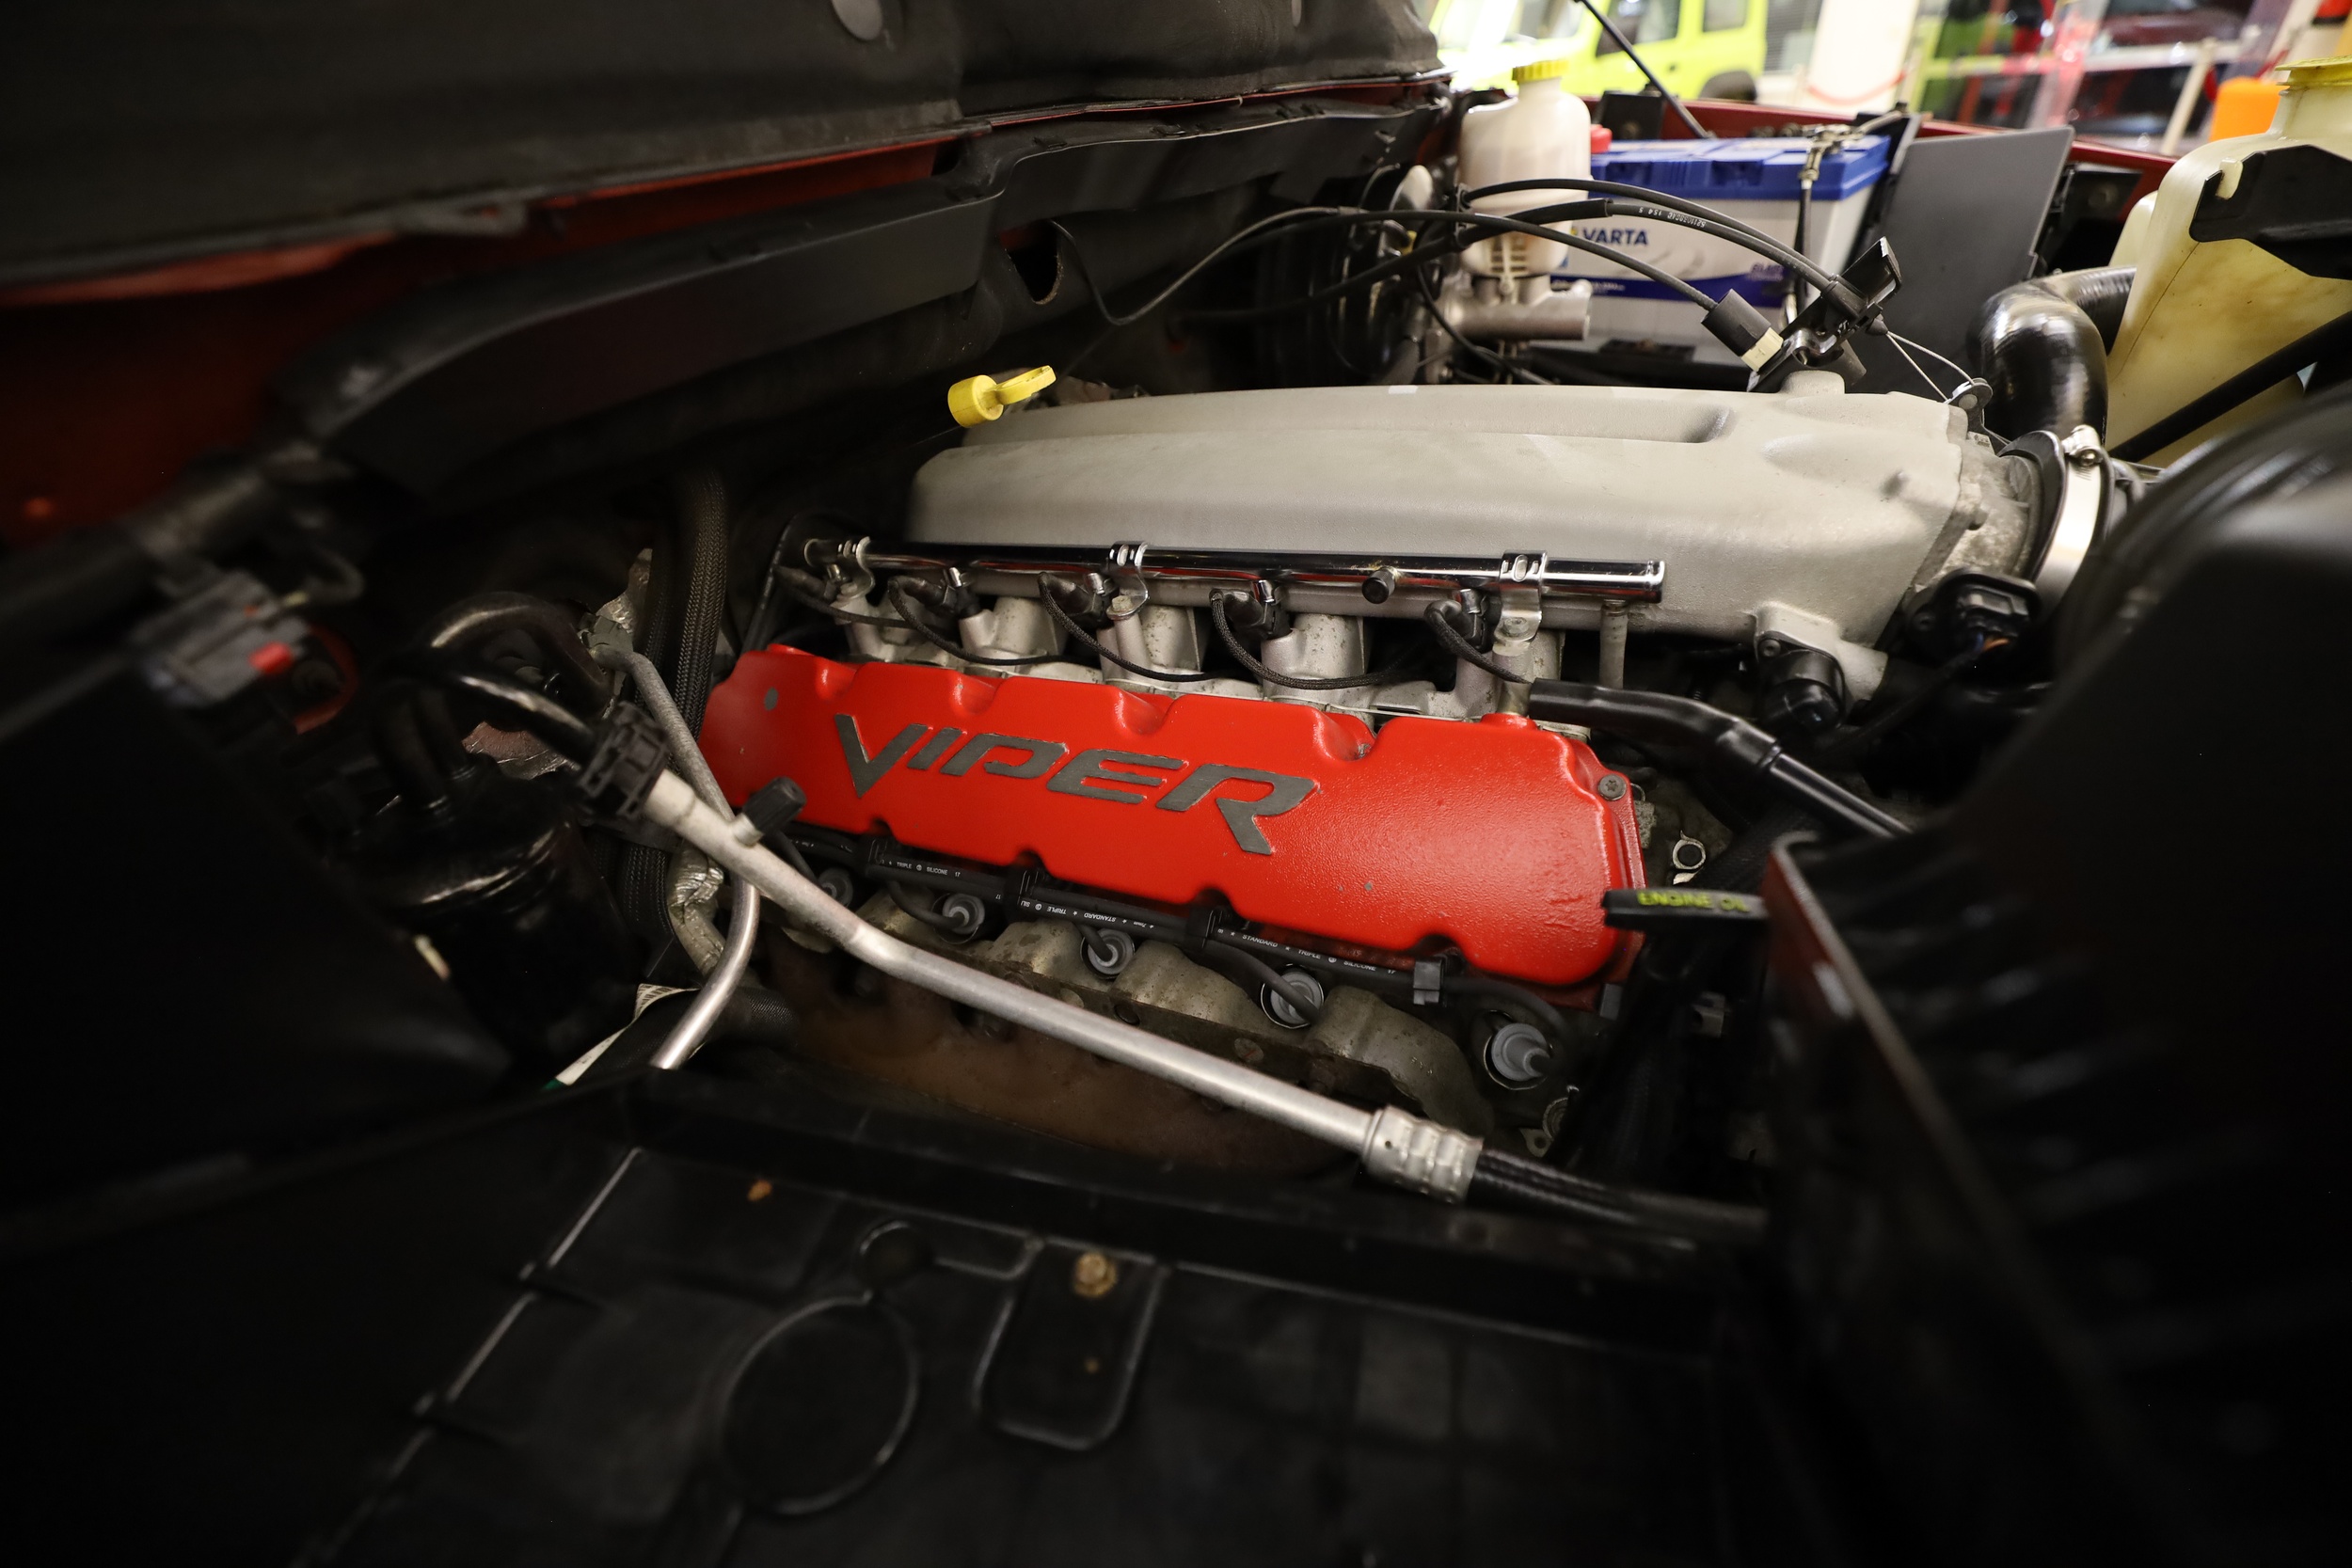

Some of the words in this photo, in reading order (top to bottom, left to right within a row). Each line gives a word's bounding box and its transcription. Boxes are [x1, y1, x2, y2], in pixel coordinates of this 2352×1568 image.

[1582, 228, 1648, 245] VARTA
[834, 712, 1319, 856] VIPER
[926, 866, 948, 876] SILICONE
[1046, 905, 1067, 915] TRIPLE
[1637, 891, 1712, 909] ENGINE
[1720, 897, 1751, 912] OIL
[1083, 912, 1117, 923] STANDARD
[1242, 934, 1279, 948] STANDARD
[1297, 948, 1321, 959] TRIPLE
[1343, 960, 1376, 972] SILICONE
